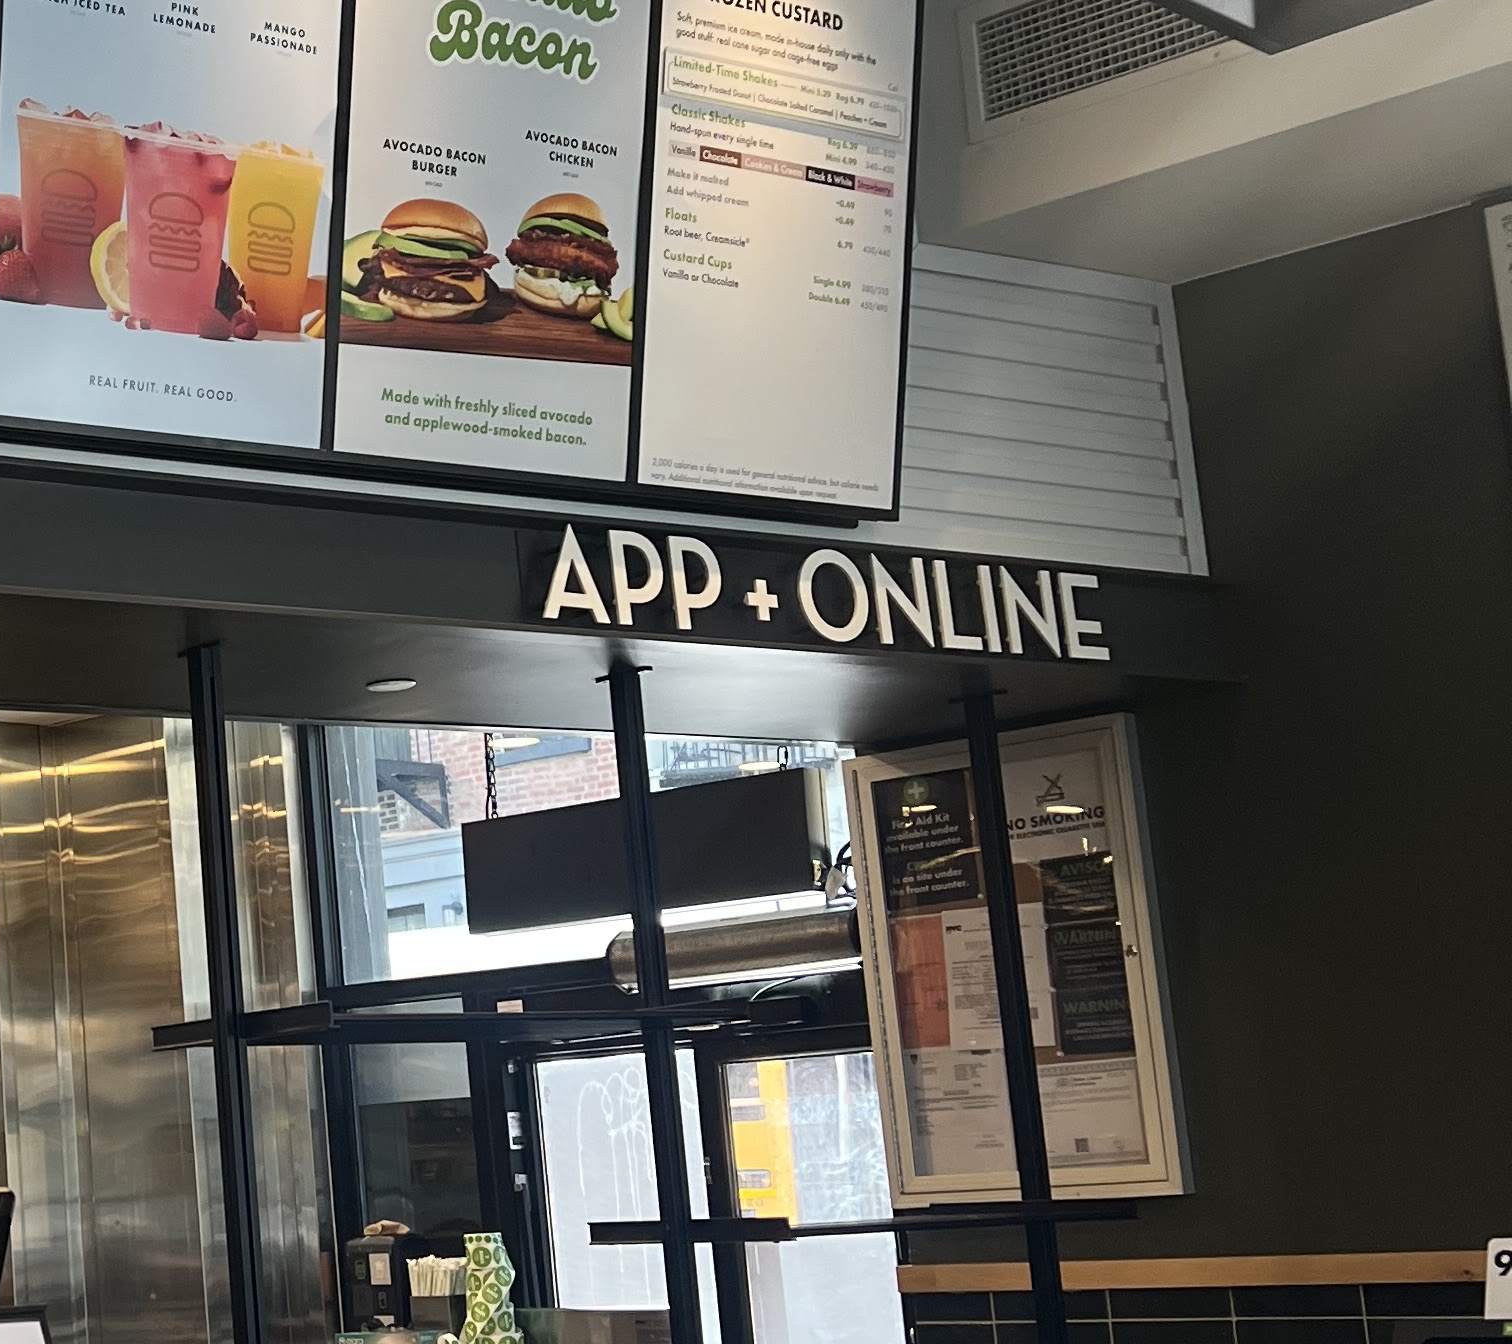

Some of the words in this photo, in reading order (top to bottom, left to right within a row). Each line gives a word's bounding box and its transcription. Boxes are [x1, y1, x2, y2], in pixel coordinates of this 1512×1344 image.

[104, 2, 125, 16] TEA
[170, 1, 199, 16] PINK
[771, 0, 843, 30] CUSTARD
[152, 12, 215, 33] LEMONADE
[263, 21, 305, 38] MANGO
[249, 32, 317, 55] PASSIONADE
[429, 0, 597, 80] Bacon
[673, 57, 739, 81] Limited-Time
[742, 67, 779, 88] Shakes
[671, 102, 707, 122] Classic
[708, 110, 747, 130] Shakes
[382, 138, 442, 157] AVOCADO
[445, 148, 486, 165] BACON
[524, 129, 578, 149] AVOCADO
[581, 140, 617, 156] BACON
[411, 159, 457, 177] BURGER
[548, 150, 593, 168] CHICKEN
[664, 206, 697, 223] Floats
[663, 248, 704, 265] Custard
[707, 255, 732, 271] Cups
[89, 374, 117, 388] REAL
[163, 383, 191, 397] REAL
[380, 387, 419, 405] Made
[422, 392, 451, 408] with
[454, 395, 499, 418] freshly
[501, 401, 537, 418] sliced
[539, 410, 592, 425] avocado
[384, 411, 410, 425] and
[413, 414, 542, 440] applewood-smoked
[545, 427, 586, 445] bacon.
[542, 523, 722, 630] APP
[744, 578, 779, 622] +
[796, 548, 1111, 661] ONLINE
